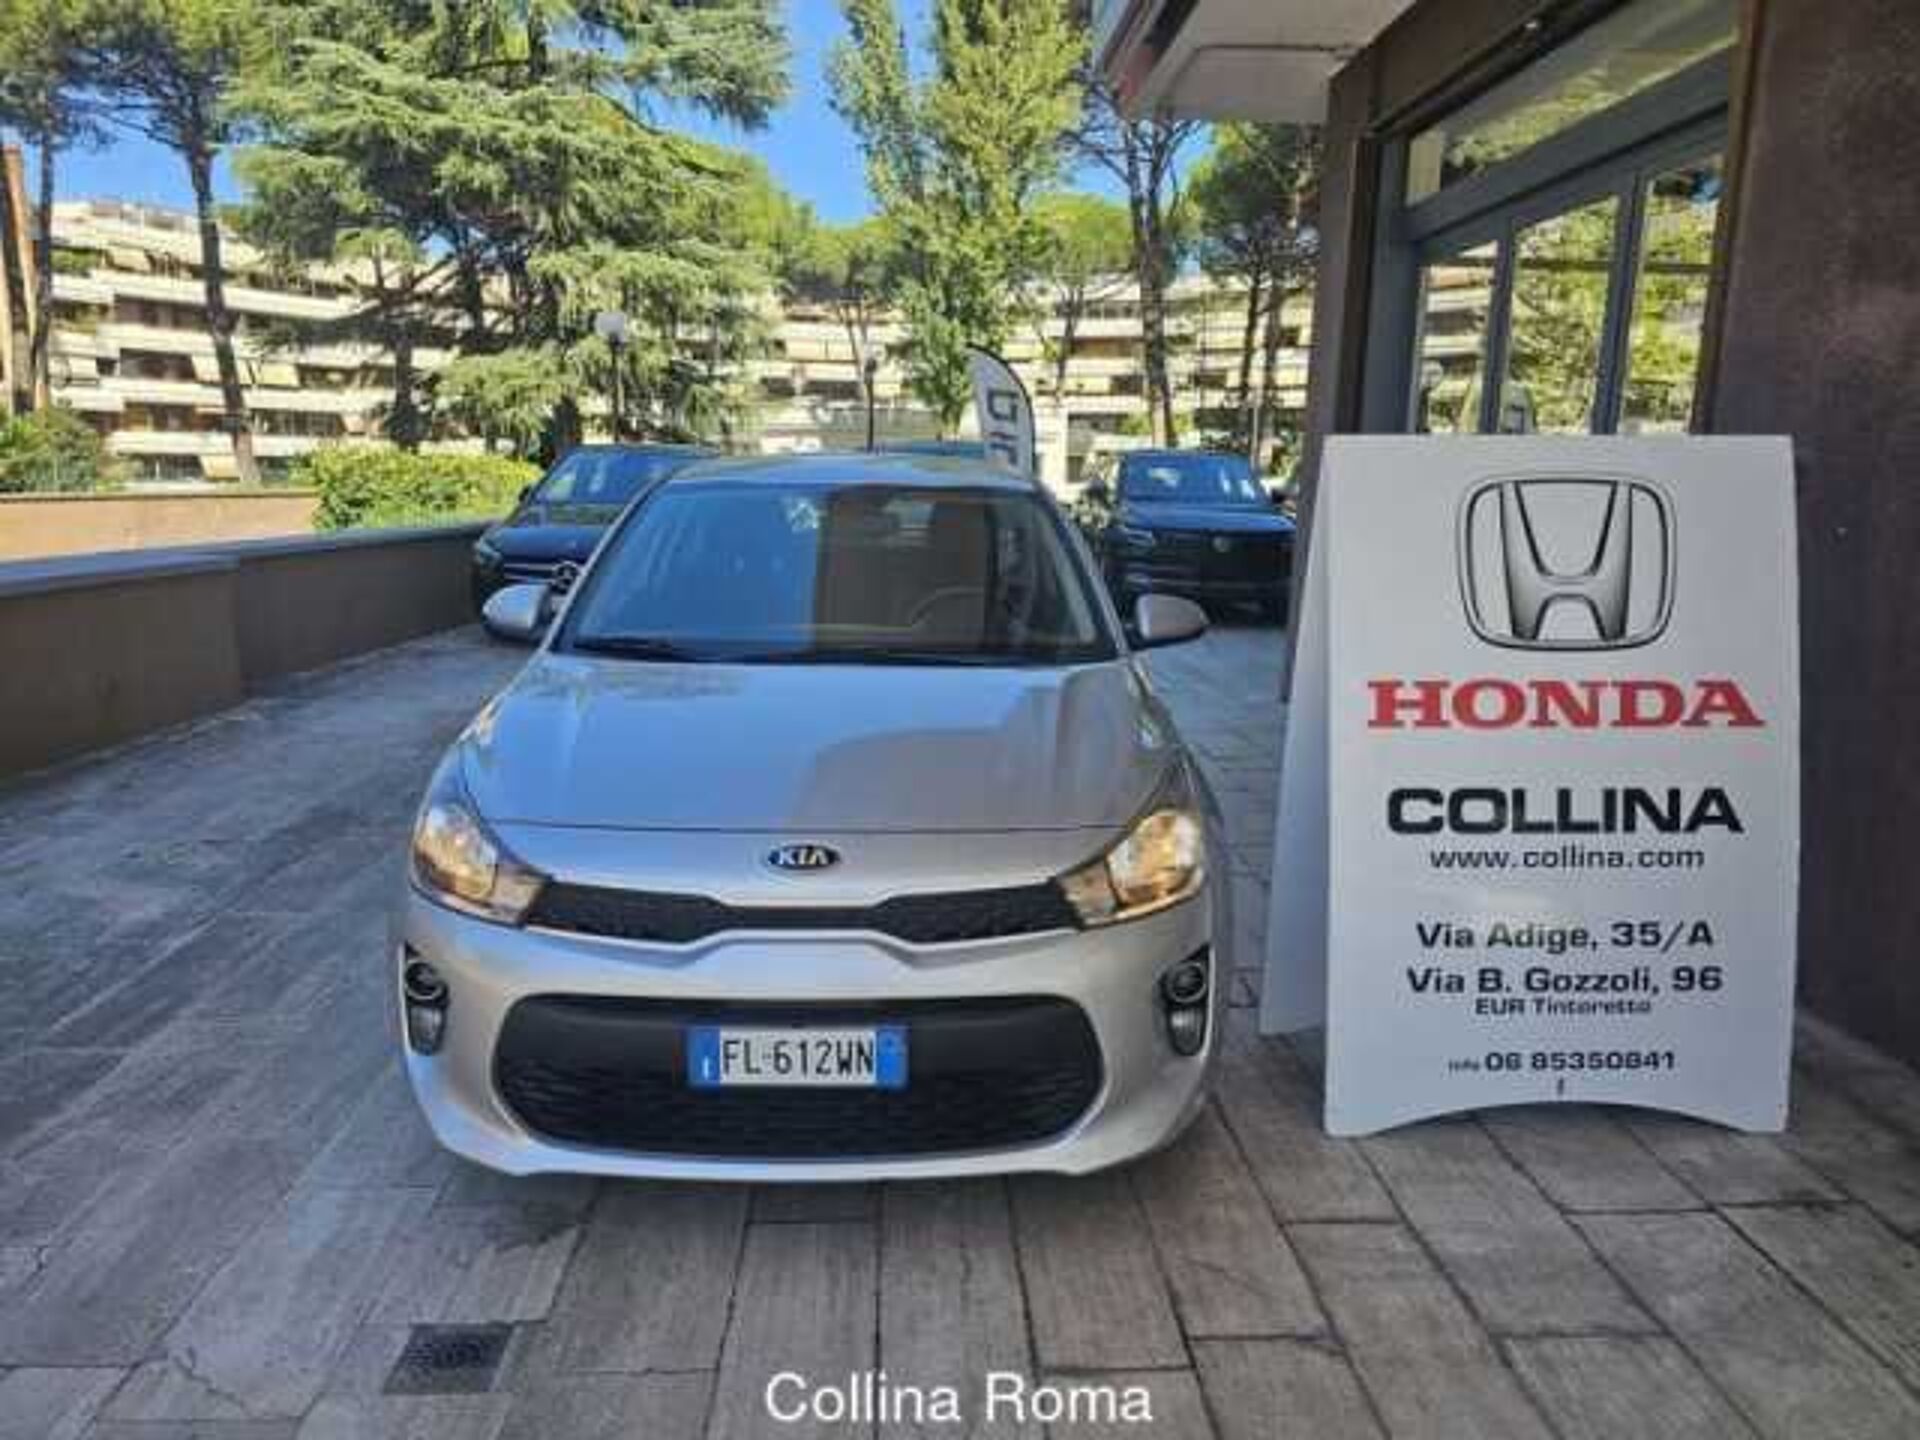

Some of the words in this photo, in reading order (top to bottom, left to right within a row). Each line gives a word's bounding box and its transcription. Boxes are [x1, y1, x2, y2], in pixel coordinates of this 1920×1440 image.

[1366, 678, 1767, 730] HONDA
[1386, 786, 1745, 836] COLLINA
[777, 847, 830, 867] KIA
[1429, 843, 1706, 870] www.collina.com
[1416, 922, 1475, 949] Via
[1485, 922, 1600, 956] Adige,
[1609, 920, 1716, 953] 35/A
[1405, 966, 1466, 994] Via
[1477, 967, 1513, 994] B.
[1523, 966, 1660, 996] Gozzoli,
[1671, 965, 1724, 992] 96
[1474, 997, 1526, 1016] EUR
[1484, 1051, 1523, 1072] 06
